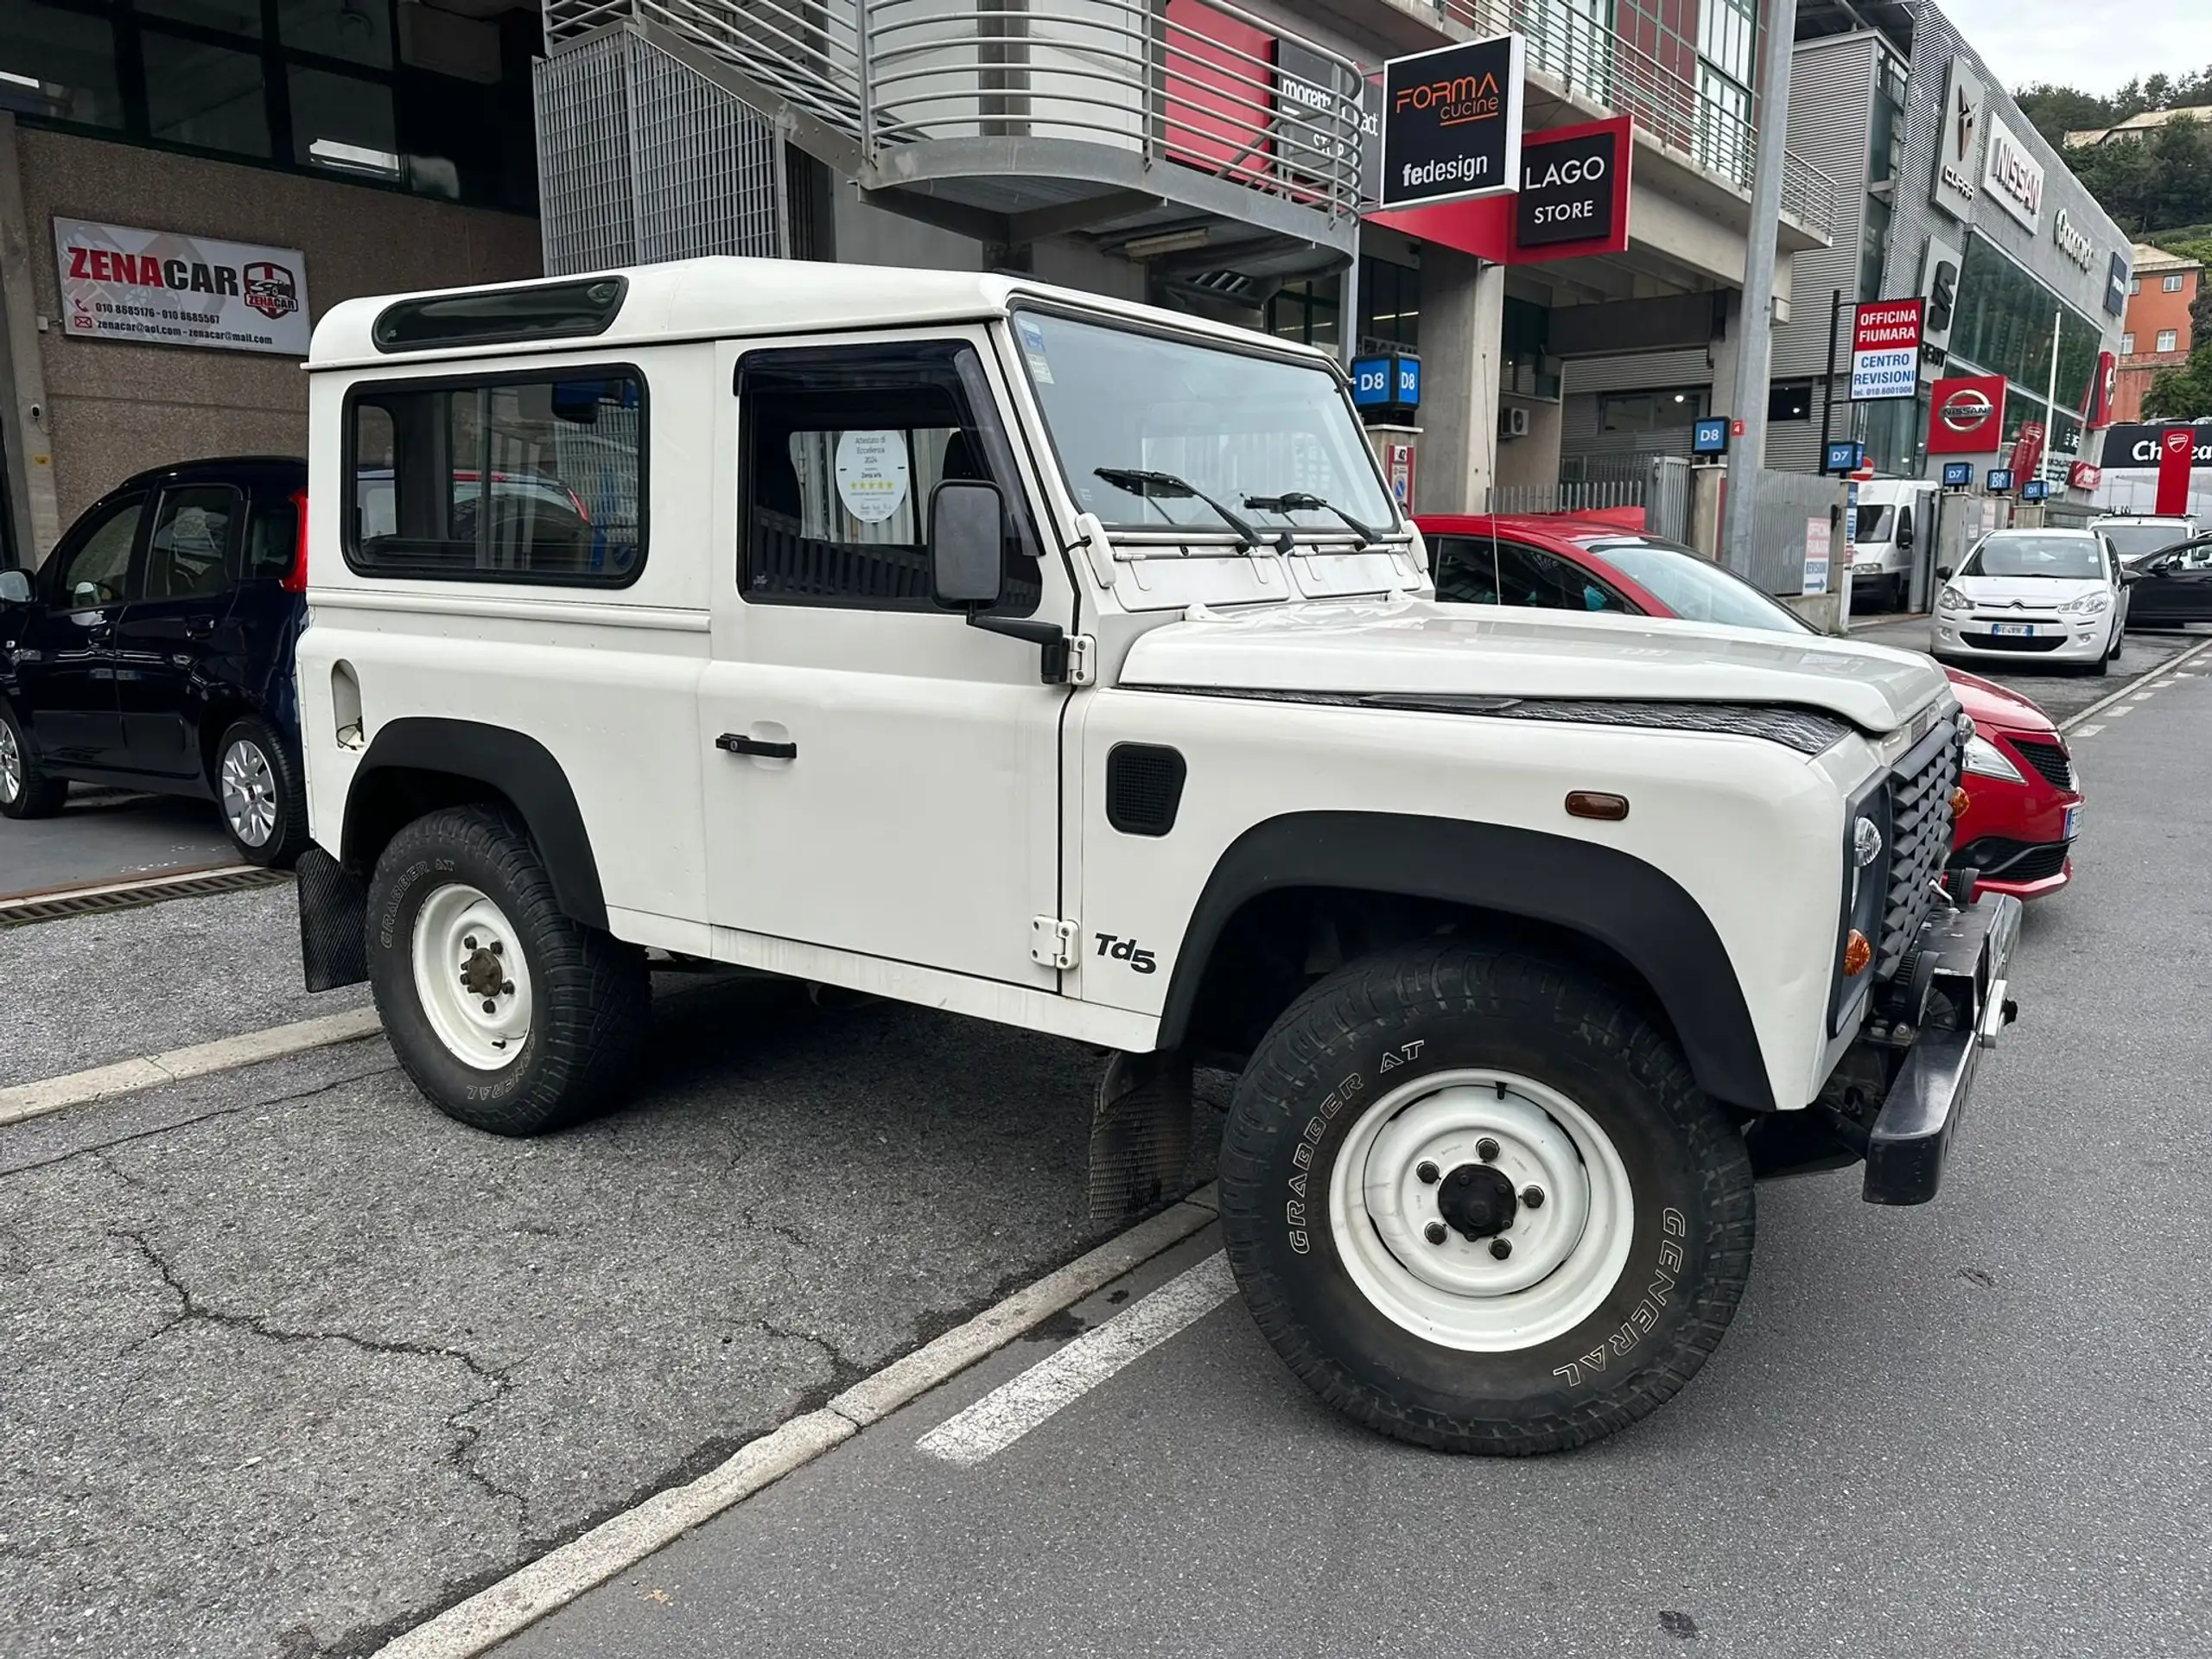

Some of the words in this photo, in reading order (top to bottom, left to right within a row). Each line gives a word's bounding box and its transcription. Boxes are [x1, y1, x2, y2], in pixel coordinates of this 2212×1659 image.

[1396, 72, 1498, 113] FORMA
[1440, 96, 1498, 119] cucine
[1402, 154, 1487, 187] fedesign
[1525, 156, 1605, 189] LAGO
[1996, 137, 2042, 214] NISSAN
[1534, 200, 1593, 224] STORE
[67, 246, 238, 296] ZENACAR
[95, 302, 112, 314] 010
[115, 303, 155, 317] 8685176
[162, 310, 178, 321] 010
[181, 311, 220, 324] 8685567
[248, 295, 295, 309] ZENACAR
[1860, 309, 1916, 326] OFFICINA
[97, 321, 181, 336] zenacar@aol.com
[188, 328, 272, 344] zenacar@mail.com
[1859, 327, 1916, 342] FIUMARA
[1861, 353, 1910, 368] CENTRO
[1361, 372, 1384, 391] D8
[1401, 372, 1415, 390] D8
[1853, 370, 1915, 385] REVISIONI
[1943, 406, 1987, 416] NISSAN
[1700, 429, 1719, 442] D8
[1832, 450, 1849, 462] D7
[1948, 469, 1963, 479] D7
[380, 861, 430, 949] GRABBER
[435, 858, 454, 873] AT
[1095, 932, 1156, 974] Td5
[1287, 1072, 1364, 1254] GRABBER
[1380, 1039, 1425, 1073] AT
[1553, 1207, 1686, 1387] GENERAL
